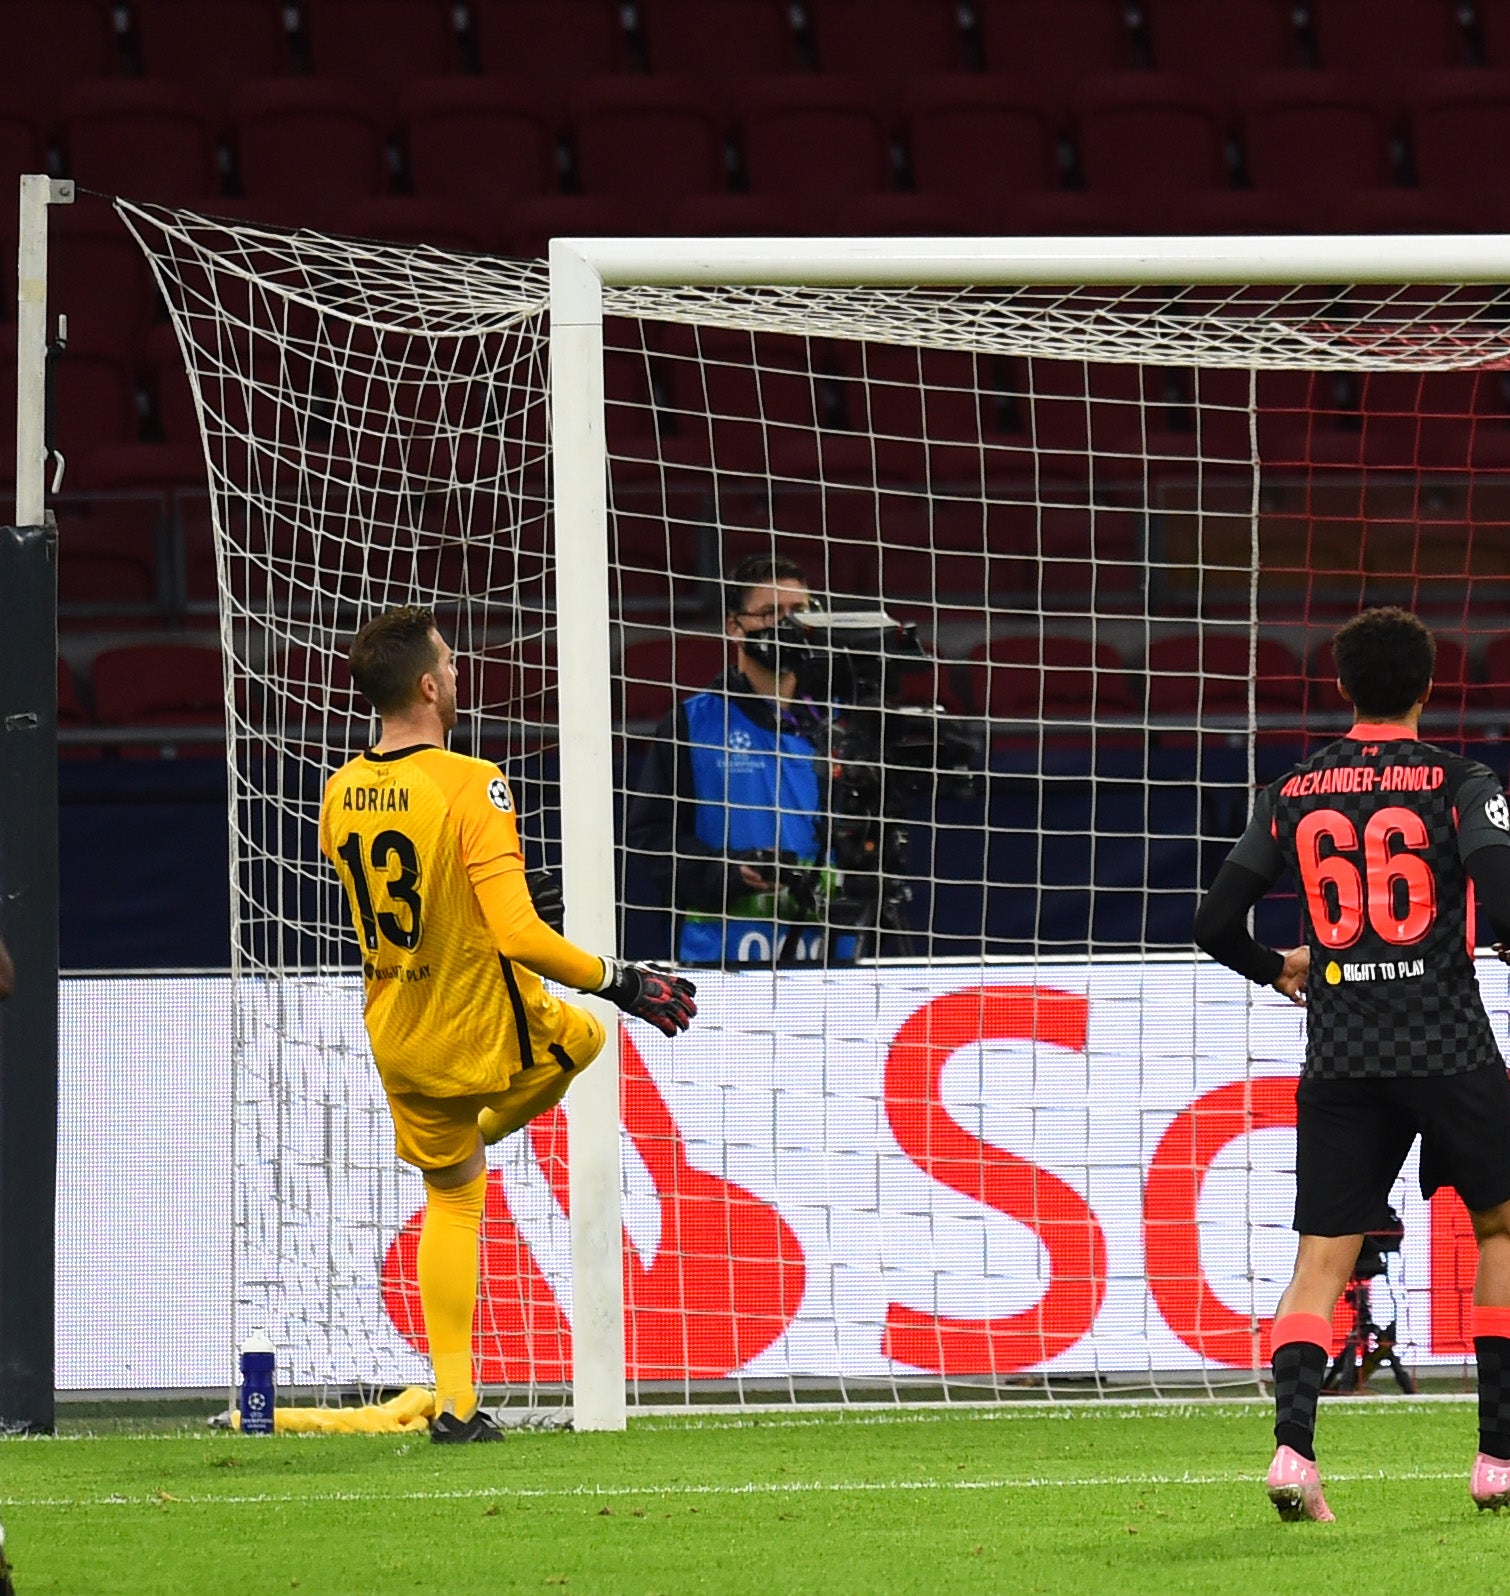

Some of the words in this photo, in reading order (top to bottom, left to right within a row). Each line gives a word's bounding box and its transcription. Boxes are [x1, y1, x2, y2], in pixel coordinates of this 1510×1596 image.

[1279, 766, 1445, 797] ALEXANDER-ARNOLD
[337, 830, 422, 955] 13
[1295, 806, 1437, 949] 66
[1343, 963, 1376, 982] RIGHT
[1378, 962, 1396, 980] TO
[1398, 959, 1424, 979] PLAY
